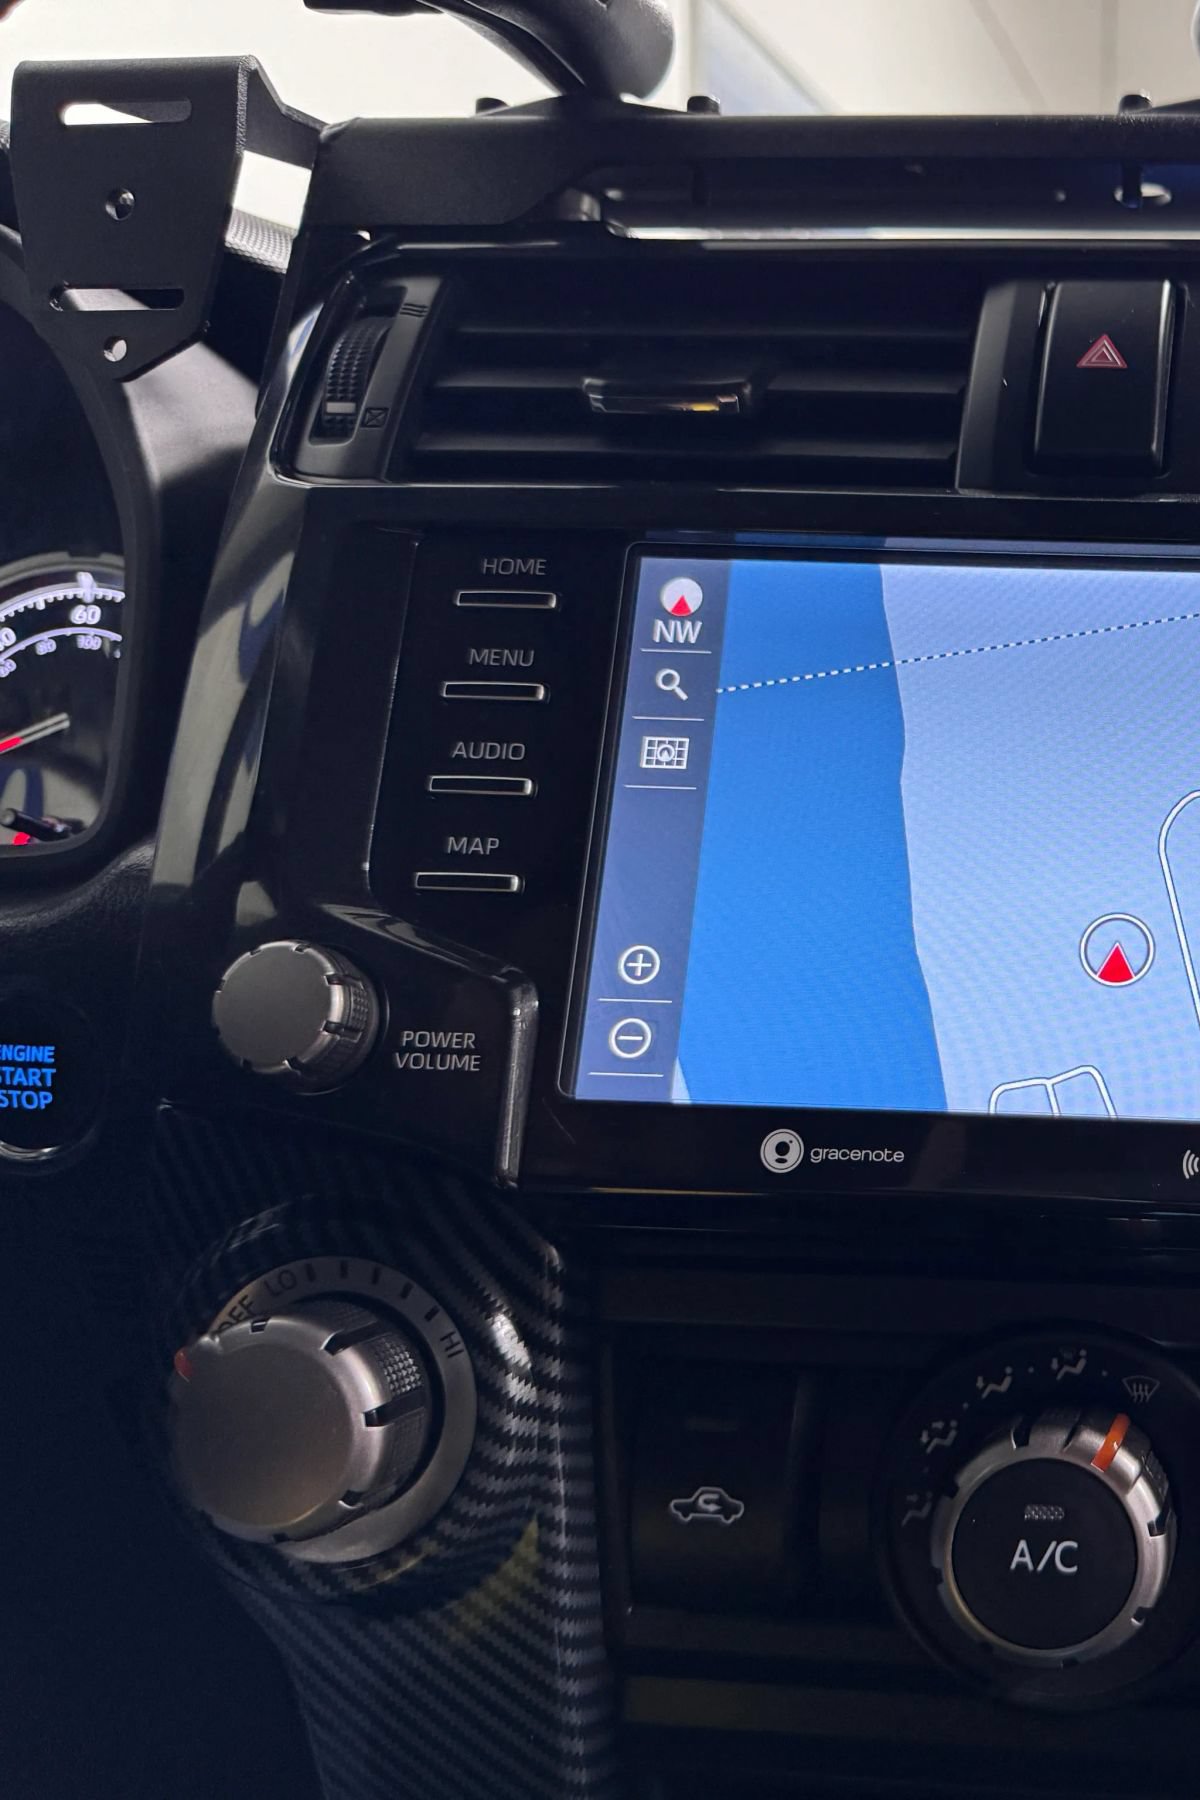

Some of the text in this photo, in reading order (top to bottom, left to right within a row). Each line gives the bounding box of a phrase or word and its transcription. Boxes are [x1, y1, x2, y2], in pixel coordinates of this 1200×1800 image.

[482, 558, 547, 575] HOME
[70, 604, 101, 624] 60
[0, 627, 17, 651] 0
[653, 618, 702, 644] NW
[469, 648, 535, 667] MENU
[452, 742, 526, 760] AUDIO
[447, 836, 500, 855] MAP
[402, 1031, 476, 1048] POWER
[0, 1044, 56, 1063] NGINE
[395, 1052, 481, 1071] VOLUME
[0, 1066, 56, 1087] TART
[0, 1089, 53, 1110] STOP
[810, 1147, 905, 1163] gracenote
[264, 1269, 298, 1297] LO
[440, 1330, 465, 1358] HI
[1010, 1539, 1079, 1574] A/C
